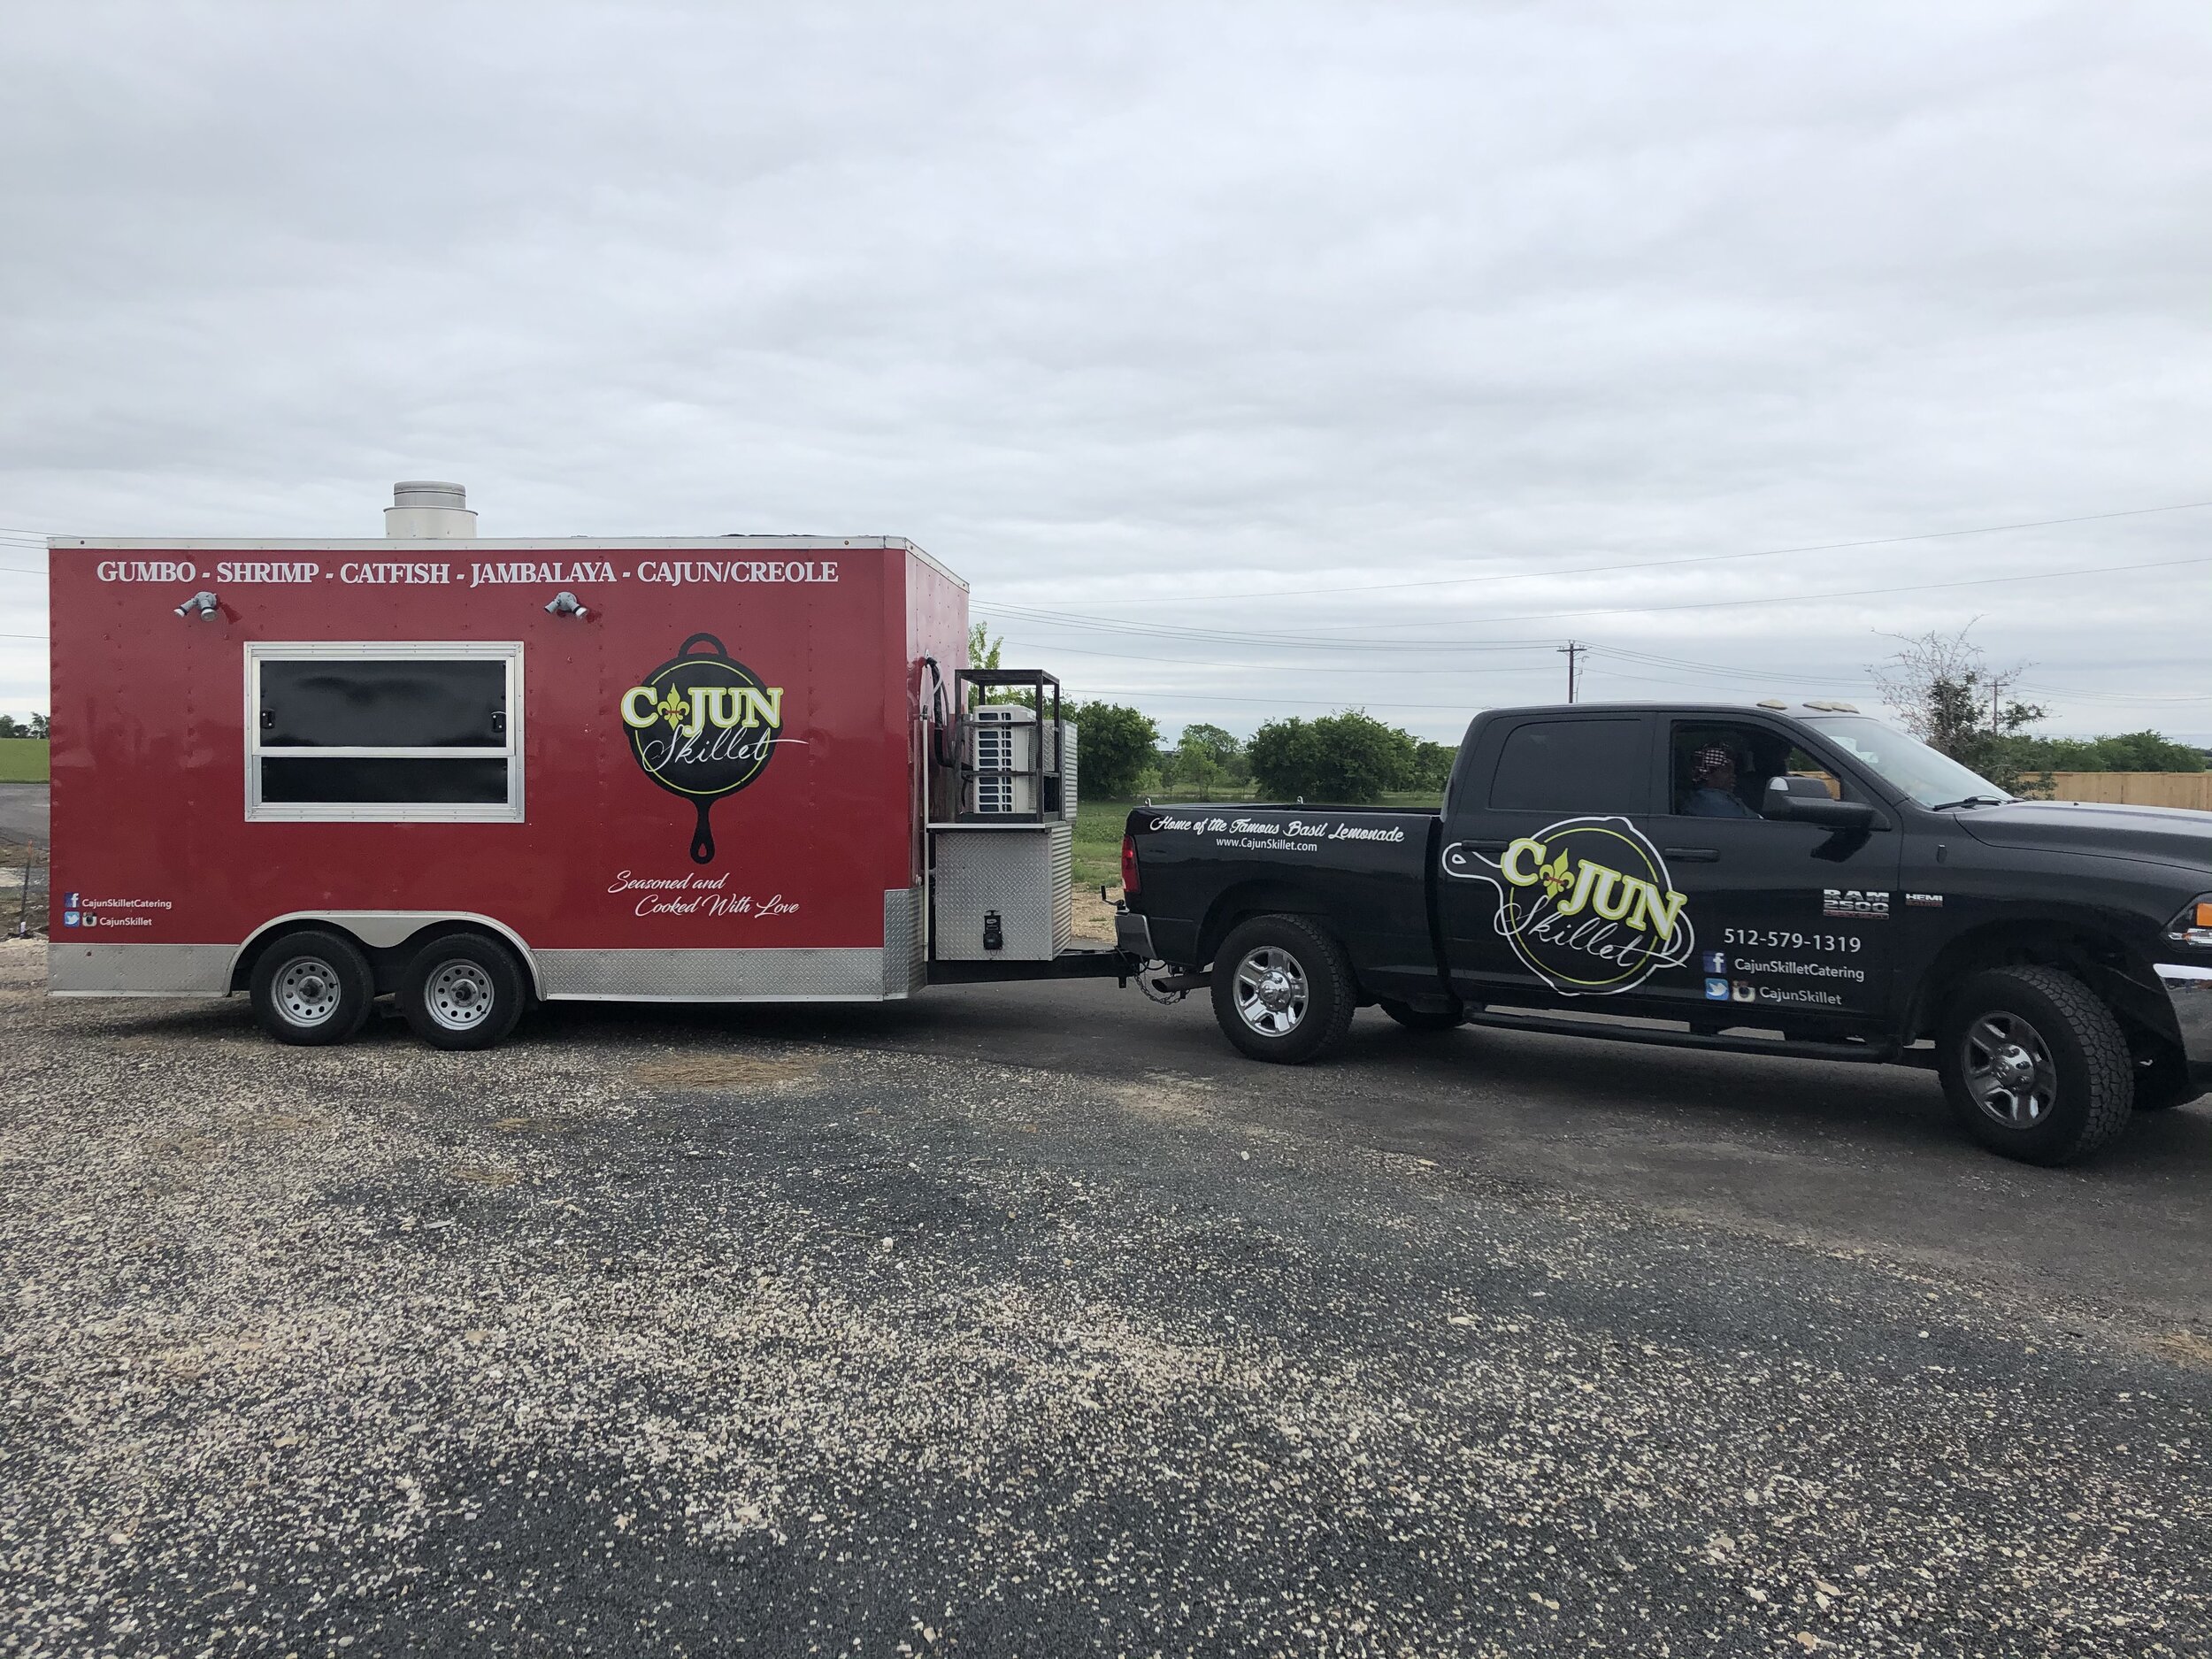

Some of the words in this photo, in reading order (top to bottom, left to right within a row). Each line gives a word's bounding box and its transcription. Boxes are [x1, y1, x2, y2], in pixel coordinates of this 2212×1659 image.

[96, 561, 196, 583] GUMBO
[217, 562, 319, 583] SHRIMP
[340, 563, 450, 584] CATFISH
[470, 563, 617, 588] JAMBALAYA
[637, 561, 839, 586] CAJUN/CREOLE
[620, 686, 784, 737] CJUN
[642, 724, 809, 772] Skillet
[1150, 816, 1192, 830] Home
[1193, 818, 1206, 834] of
[1207, 818, 1227, 832] the
[1229, 818, 1279, 834] Famous
[1282, 820, 1328, 837] Basil
[1328, 823, 1405, 842] Lemonade
[1216, 837, 1317, 852] www.CajunSkillet.com
[607, 870, 694, 893] Seasoned
[692, 872, 730, 889] and
[1500, 837, 1688, 941] CJUN
[81, 898, 173, 910] CajunSkilletCatering
[634, 894, 703, 917] Cooked
[701, 893, 754, 917] With
[754, 894, 800, 918] Love
[1824, 889, 1889, 902] RAM
[1824, 900, 1889, 912] 2500
[99, 917, 152, 928] CajunSkillet
[1494, 895, 1687, 968] Skillet
[1724, 929, 1862, 953] 512-579-1319
[1734, 958, 1864, 983] CajunSkilletCatering
[1759, 987, 1842, 1006] CajunSkillet
